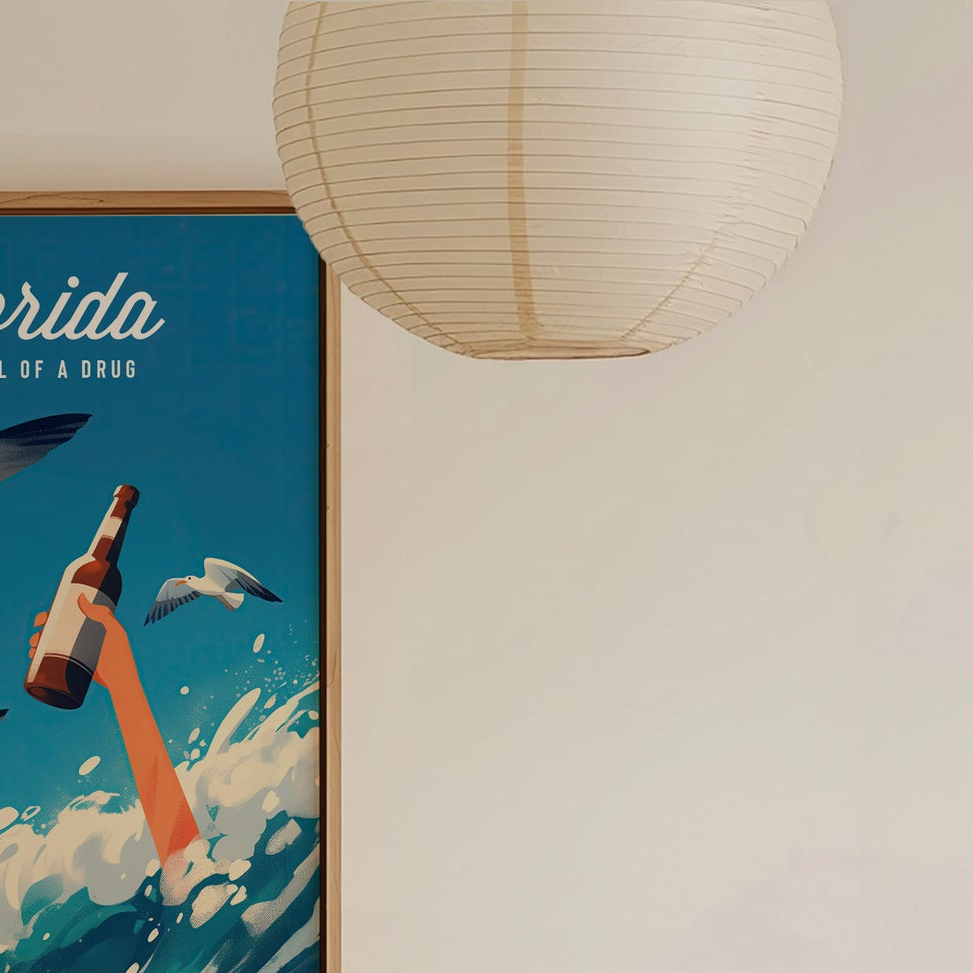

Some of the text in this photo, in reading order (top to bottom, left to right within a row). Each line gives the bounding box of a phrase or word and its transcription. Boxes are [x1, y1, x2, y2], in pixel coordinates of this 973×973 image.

[20, 360, 44, 379] OF
[57, 360, 68, 379] A
[81, 360, 136, 379] DRUG
